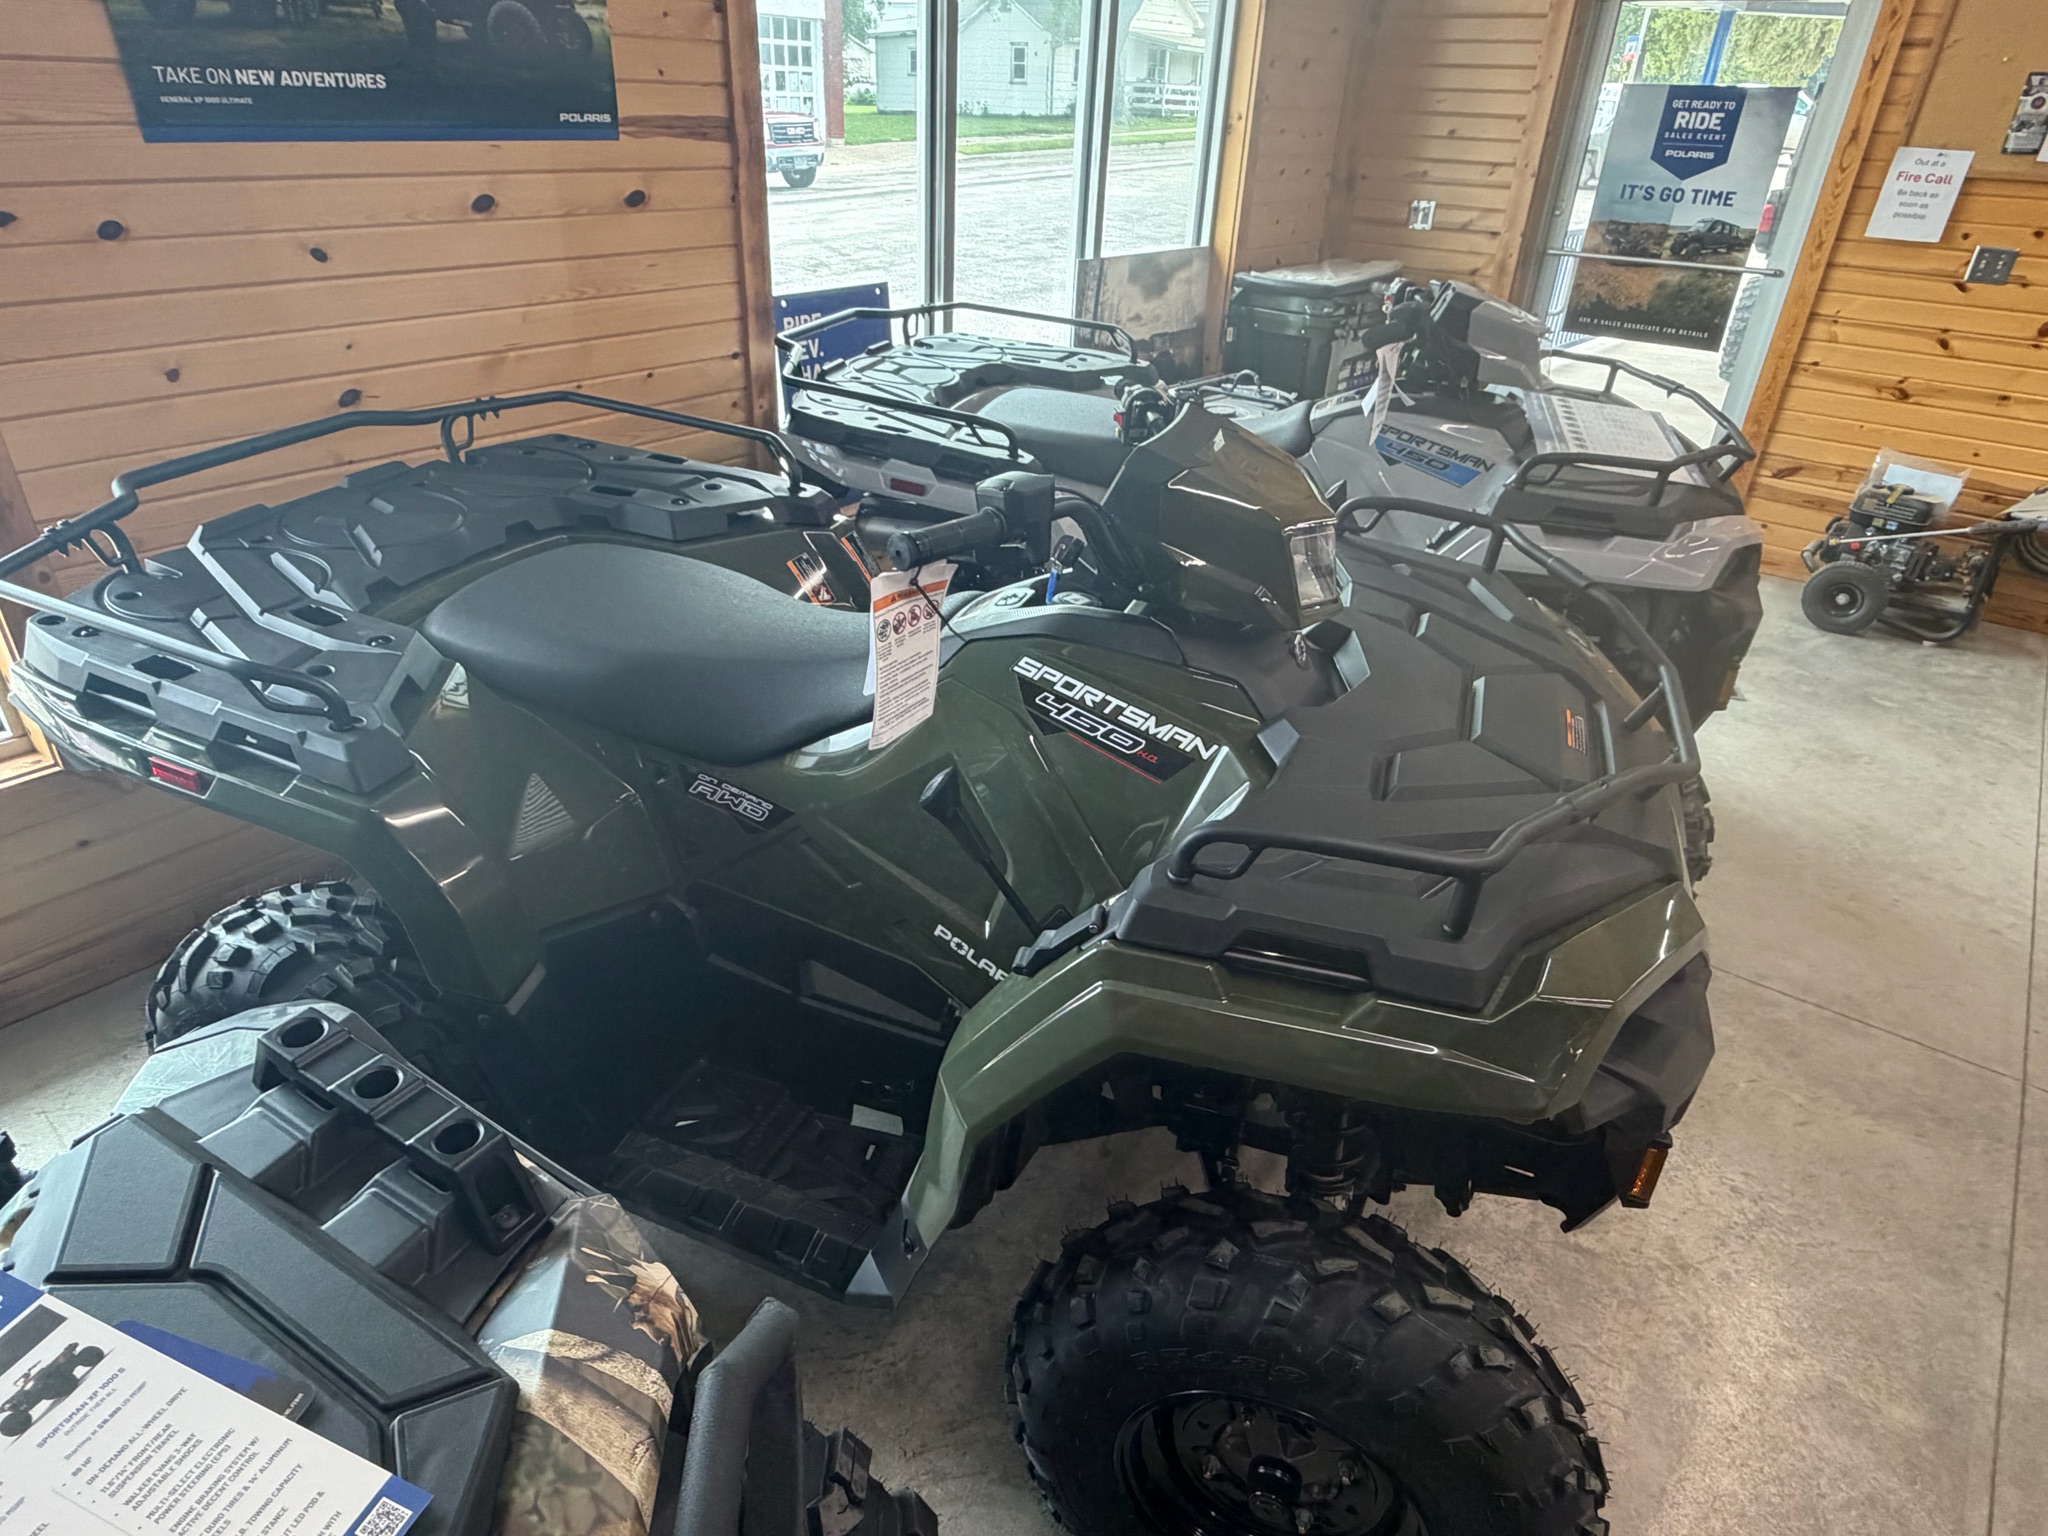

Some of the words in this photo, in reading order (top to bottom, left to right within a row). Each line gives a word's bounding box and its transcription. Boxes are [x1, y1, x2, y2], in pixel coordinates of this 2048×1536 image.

[152, 65, 204, 85] TAKE
[206, 66, 233, 85] ON
[234, 68, 275, 87] NEW
[280, 70, 387, 89] ADVENTURES
[559, 112, 612, 123] POLARIS
[1672, 99, 1690, 109] GET
[1691, 100, 1722, 109] READY
[1724, 101, 1736, 110] TO
[1673, 111, 1725, 131] RIDE
[1664, 131, 1693, 140] SALES
[1696, 133, 1727, 141] EVENT
[1664, 149, 1715, 160] POLARIS
[1619, 183, 1656, 202] IT'S
[1658, 186, 1686, 203] GO
[1690, 188, 1738, 207] TIME
[1896, 171, 1922, 183] Fire
[1924, 173, 1954, 185] Call
[1376, 424, 1496, 473] SPORTSMAN
[1386, 442, 1452, 472] 450
[1012, 655, 1219, 761] SPORTSMAN
[1035, 691, 1146, 755] 450
[688, 779, 769, 822] AWD
[36, 1401, 89, 1449] SPORTSMAN
[86, 1390, 99, 1402] XP
[98, 1373, 119, 1390] 1000
[63, 1436, 93, 1461] Starting
[85, 1444, 130, 1486] ON-DEMAND
[128, 1407, 169, 1445] ALL-WHEEL
[165, 1386, 188, 1407] DRIVE
[127, 1423, 173, 1466] FRONT/REAR
[108, 1454, 153, 1499] SUSPENSION
[150, 1429, 180, 1454] TRAVEL
[122, 1476, 154, 1506] WALKER
[151, 1454, 177, 1478] EVANS
[173, 1432, 196, 1455] 3-WAY
[131, 1465, 176, 1512] ADJUSTABLE
[174, 1438, 203, 1466] SHOCKS
[145, 1469, 195, 1520] MULTI-SELECT
[193, 1427, 235, 1470] ELECTRONIC
[153, 1497, 182, 1525] POWER
[178, 1463, 213, 1498] STEERING
[210, 1444, 232, 1464] (EPS)
[168, 1505, 197, 1533] ENGINE
[194, 1474, 226, 1506] BRAKING
[223, 1446, 251, 1474] SYSTEM
[247, 1436, 260, 1447] W/
[178, 1510, 204, 1536] ACTIVE
[201, 1481, 229, 1511] DECENT
[227, 1451, 260, 1482] CONTROL
[203, 1512, 225, 1534] DURO
[222, 1491, 245, 1512] TIRES
[258, 1438, 293, 1474] ALUMINUM
[245, 1497, 274, 1526] TOWING
[271, 1463, 303, 1498] CAPACITY
[260, 1506, 289, 1536] STANCE
[289, 1512, 306, 1529] LED
[302, 1497, 319, 1514] POD
[322, 1510, 342, 1531] WITH
